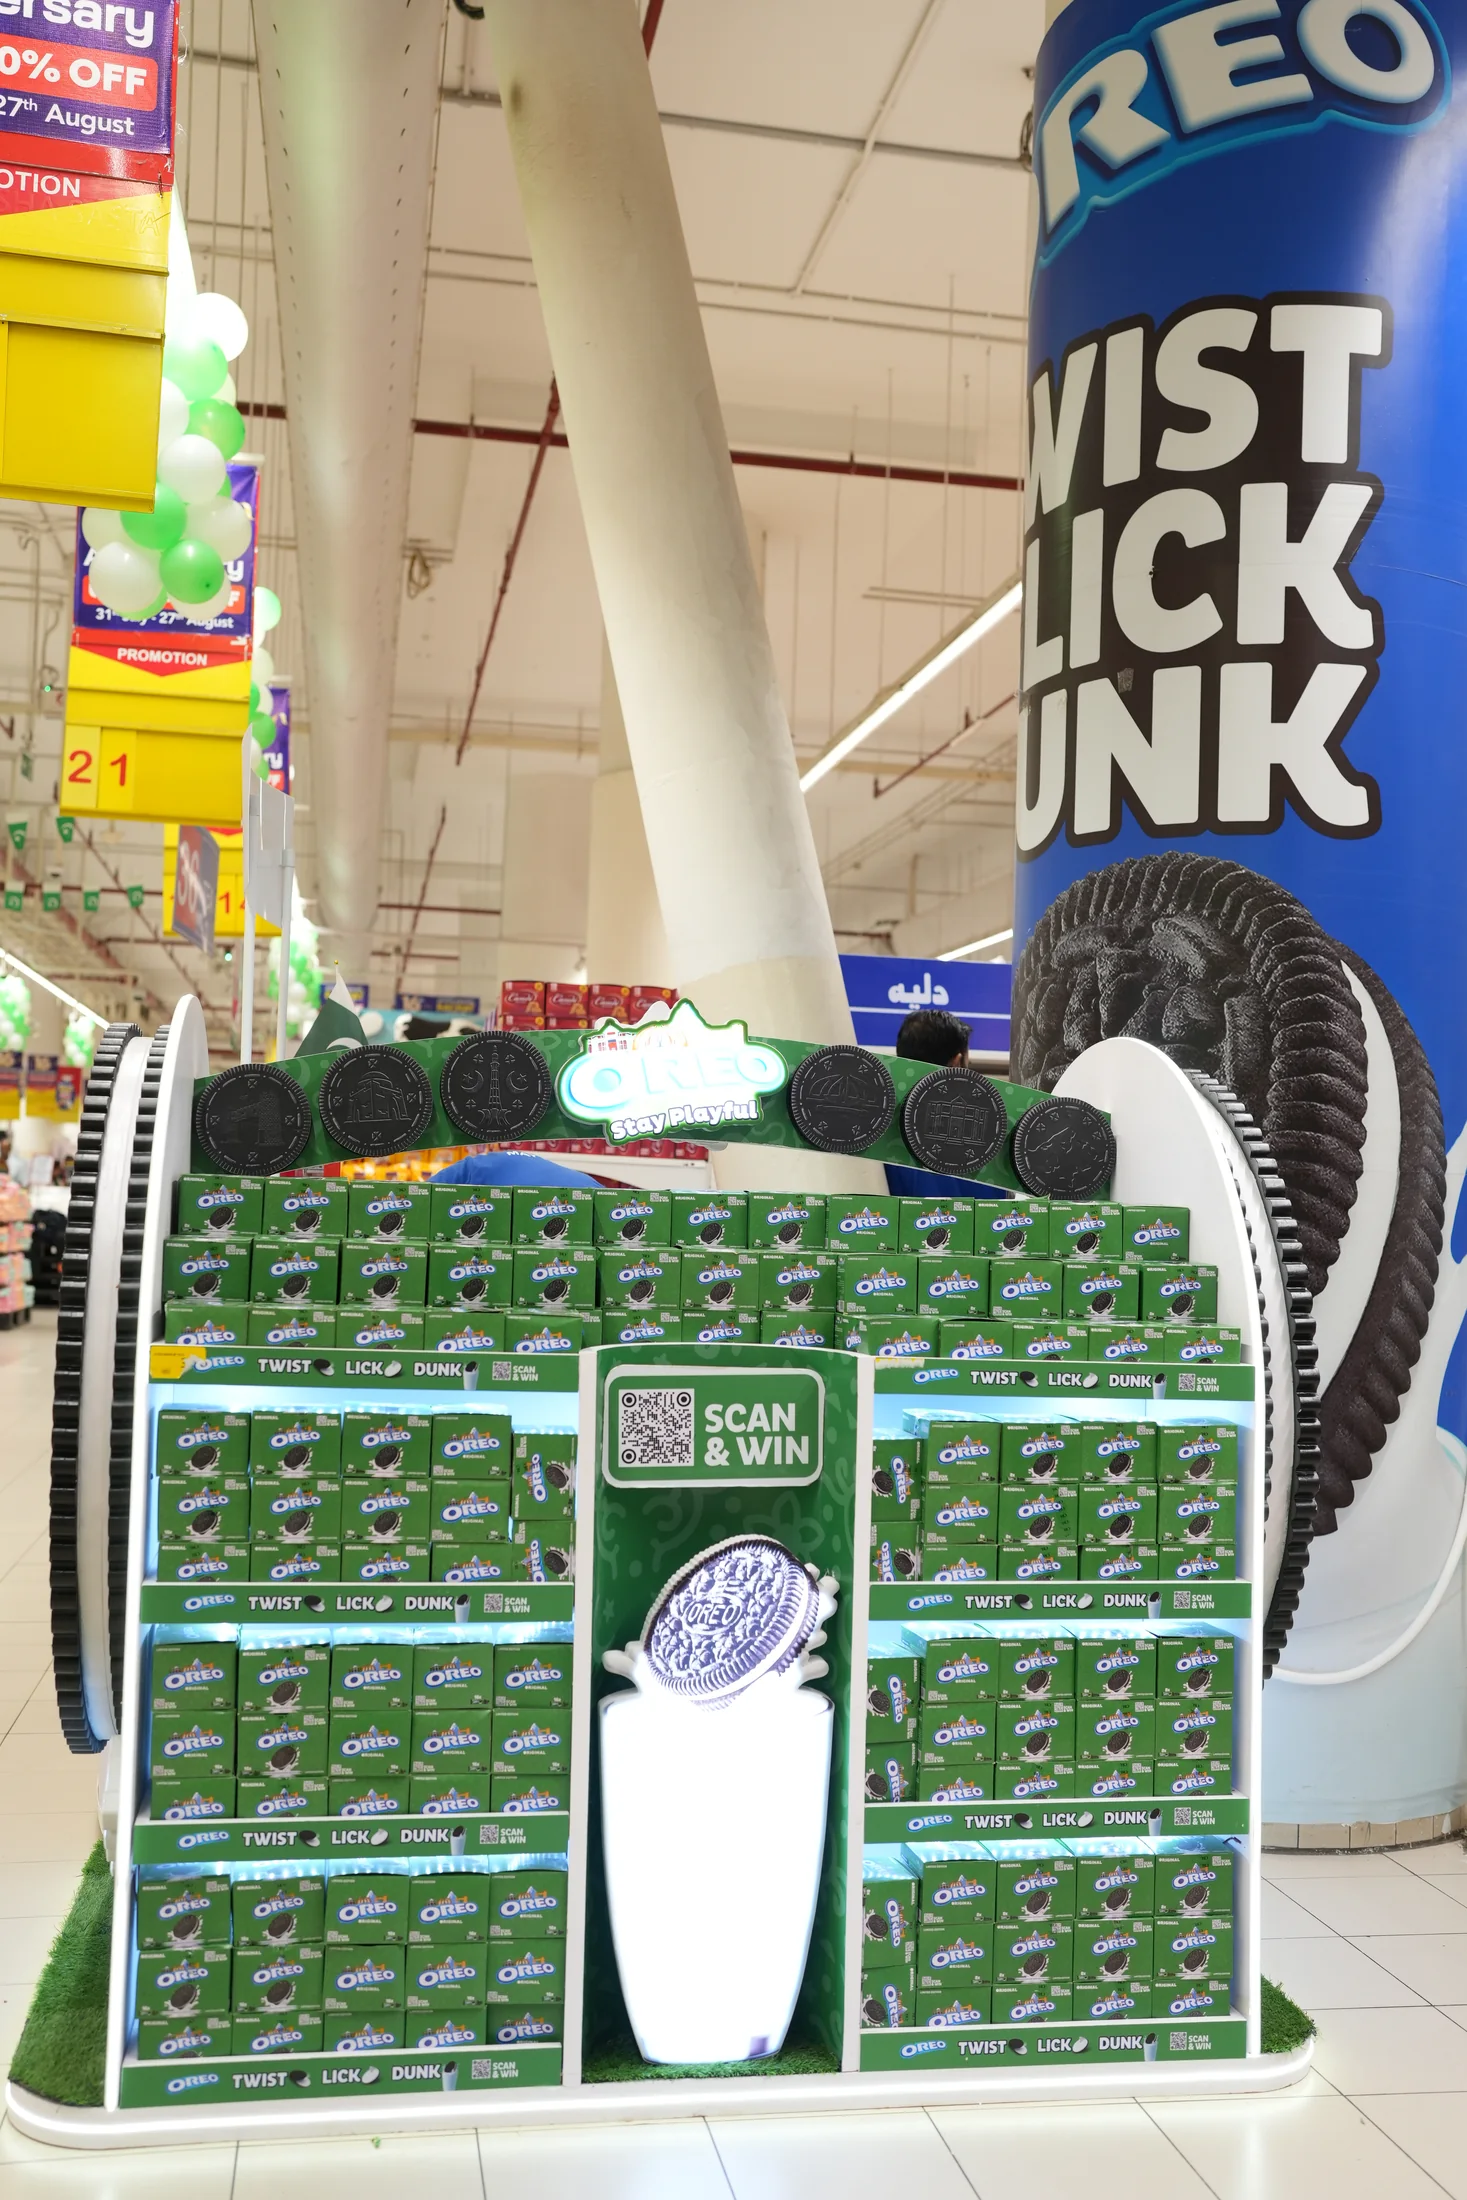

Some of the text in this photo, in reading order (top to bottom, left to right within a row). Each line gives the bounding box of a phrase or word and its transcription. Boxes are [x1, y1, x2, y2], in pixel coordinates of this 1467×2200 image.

[69, 58, 147, 95] OFF
[45, 103, 135, 136] August
[1024, 482, 1375, 687] LICK
[117, 648, 208, 666] PROMOTION
[1016, 662, 1370, 851] UNK
[888, 973, 949, 1008] دليه
[612, 1101, 758, 1141] Stay Playful
[197, 1193, 244, 1207] OREO
[767, 1209, 809, 1223] OREO
[839, 1216, 889, 1231] OREO
[1065, 1219, 1105, 1234] OREO
[270, 1261, 319, 1276] OREO
[361, 1261, 408, 1277] OREO
[855, 1278, 906, 1294] OREO
[929, 1279, 978, 1296] OREO
[1002, 1281, 1052, 1297] OREO
[259, 1359, 311, 1373] TWIST
[346, 1361, 383, 1375] LICK
[414, 1362, 462, 1377] DUNK
[520, 1373, 538, 1381] WIN
[914, 1369, 1151, 1387] OREO TWIST LICK DUNK
[705, 1403, 796, 1433] SCAN
[177, 1431, 228, 1447] OREO
[270, 1431, 320, 1447] OREO
[362, 1431, 411, 1446] OREO
[443, 1439, 500, 1457] OREO
[704, 1436, 809, 1466] & WIN
[938, 1446, 990, 1462] OREO
[1021, 1441, 1065, 1456] OREO
[533, 1455, 547, 1501] OREO
[892, 1457, 905, 1503] OREO
[179, 1496, 228, 1511] OREO
[271, 1496, 321, 1512] OREO
[442, 1503, 499, 1521] OREO
[937, 1507, 988, 1524] OREO
[185, 1595, 453, 1610] OREO TWIST LICK DUNK
[908, 1594, 1146, 1610] OREO TWIST LICK DUNK
[687, 1604, 735, 1625] OREO
[937, 1664, 989, 1681] OREO
[1015, 1656, 1057, 1672] OREO
[165, 1669, 223, 1688] OREO
[259, 1667, 308, 1683] OREO
[344, 1669, 400, 1688] OREO
[425, 1668, 481, 1686] OREO
[505, 1668, 561, 1687] OREO
[889, 1676, 902, 1722] OREO
[1173, 1716, 1215, 1731] OREO
[258, 1731, 307, 1748] OREO
[424, 1734, 479, 1753] OREO
[503, 1734, 559, 1753] OREO
[934, 1726, 986, 1744] OREO
[164, 1736, 223, 1755] OREO
[342, 1736, 398, 1754] OREO
[908, 1812, 1147, 1830] OREO TWIST LICK DUNK
[179, 1830, 448, 1847] OREO TWIST LICK DUNK
[933, 1886, 985, 1904] OREO
[160, 1899, 210, 1917] OREO
[338, 1901, 396, 1920] OREO
[420, 1901, 477, 1920] OREO
[501, 1897, 556, 1916] OREO
[886, 1900, 899, 1946] OREO
[1172, 1935, 1215, 1950] OREO
[931, 1948, 983, 1967] OREO
[157, 1968, 207, 1985] OREO
[254, 1965, 303, 1983] OREO
[336, 1970, 394, 1989] OREO
[418, 1968, 475, 1987] OREO
[498, 1963, 555, 1982] OREO
[901, 2037, 1142, 2056] OREO TWIST LICK DUNK
[167, 2066, 440, 2092] OREO TWIST LICK DUNK
